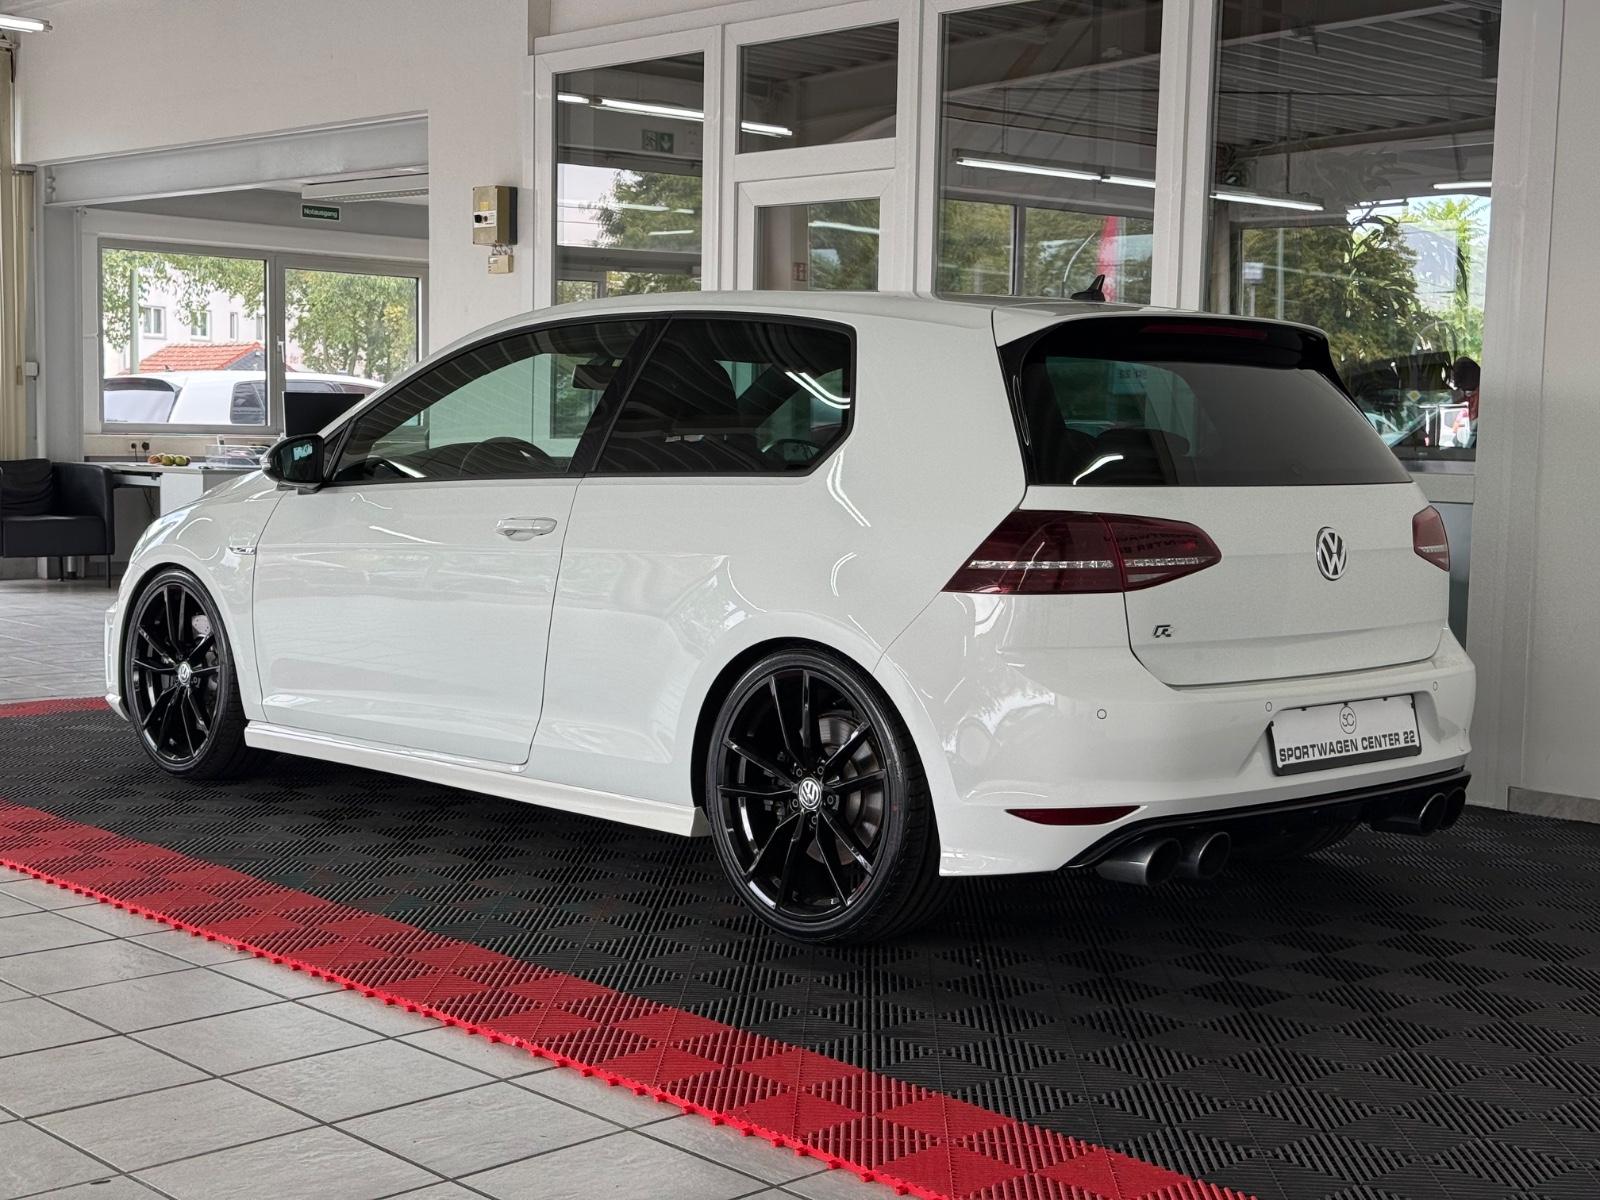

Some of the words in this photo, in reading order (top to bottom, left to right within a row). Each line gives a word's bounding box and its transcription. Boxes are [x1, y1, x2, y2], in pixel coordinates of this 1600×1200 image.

[303, 207, 338, 219] Notausgang
[1279, 738, 1359, 762] SPORTWAGEN
[1361, 731, 1401, 751] CENTER
[1403, 730, 1416, 744] 22
